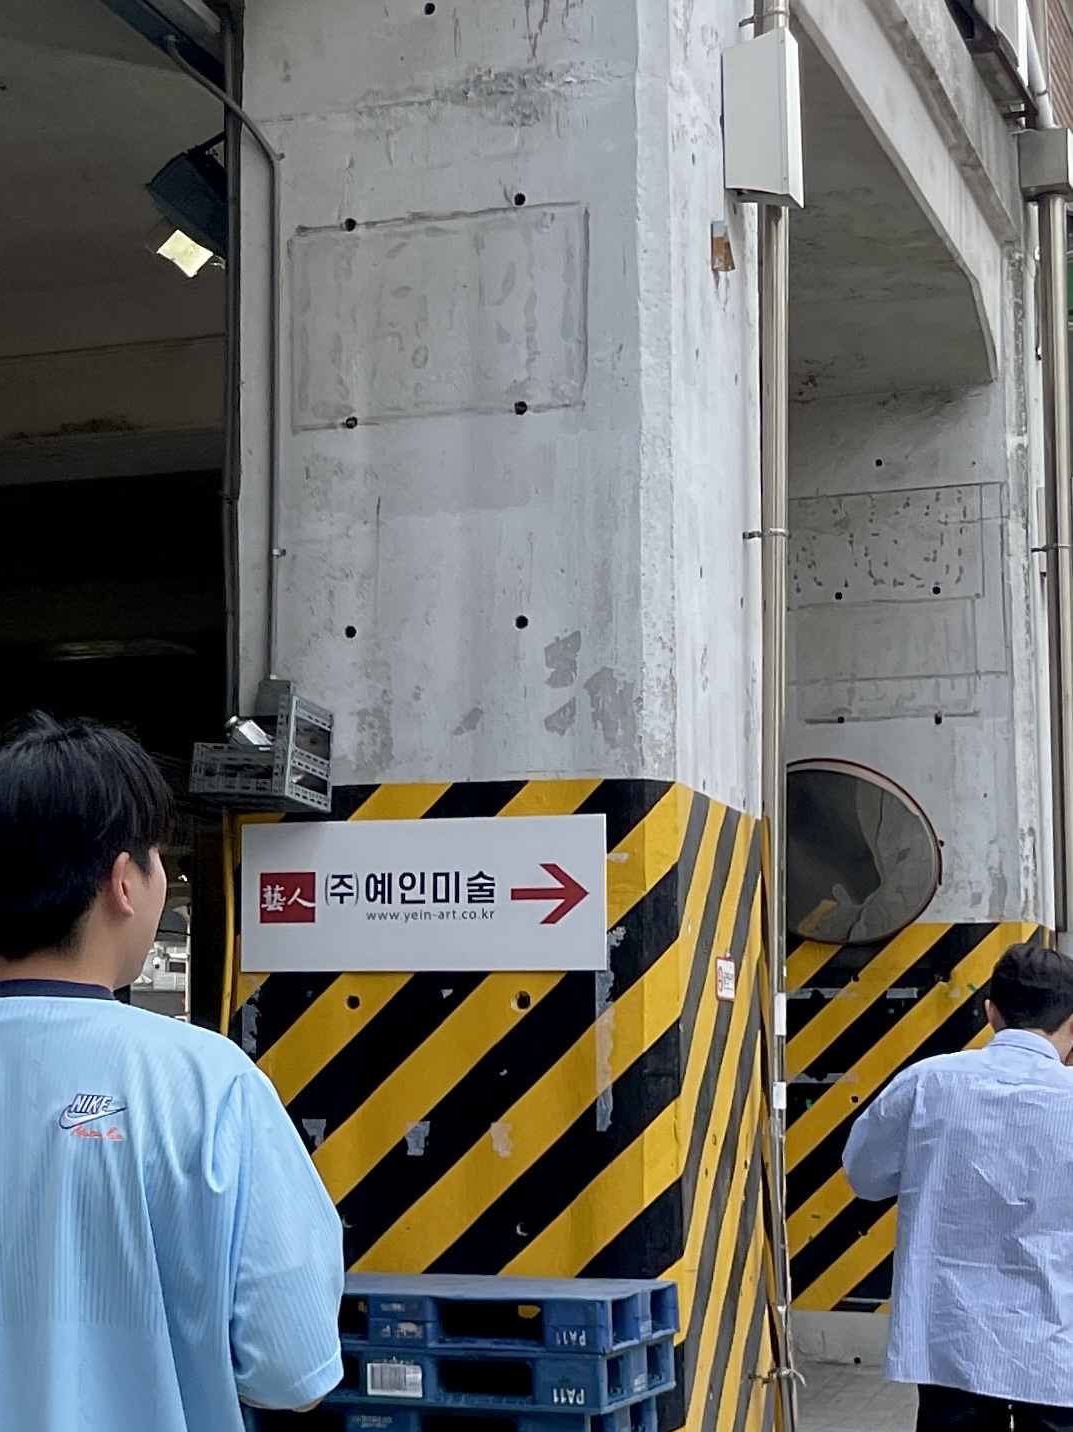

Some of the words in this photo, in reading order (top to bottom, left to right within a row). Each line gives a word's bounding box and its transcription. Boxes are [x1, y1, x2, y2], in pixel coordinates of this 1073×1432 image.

[325, 870, 496, 906] (주)예인미술
[365, 908, 495, 923] www.yein-art.co.kr
[70, 1093, 113, 1114] NIKE
[555, 1329, 587, 1347] PA11
[553, 1387, 585, 1405] PA11
